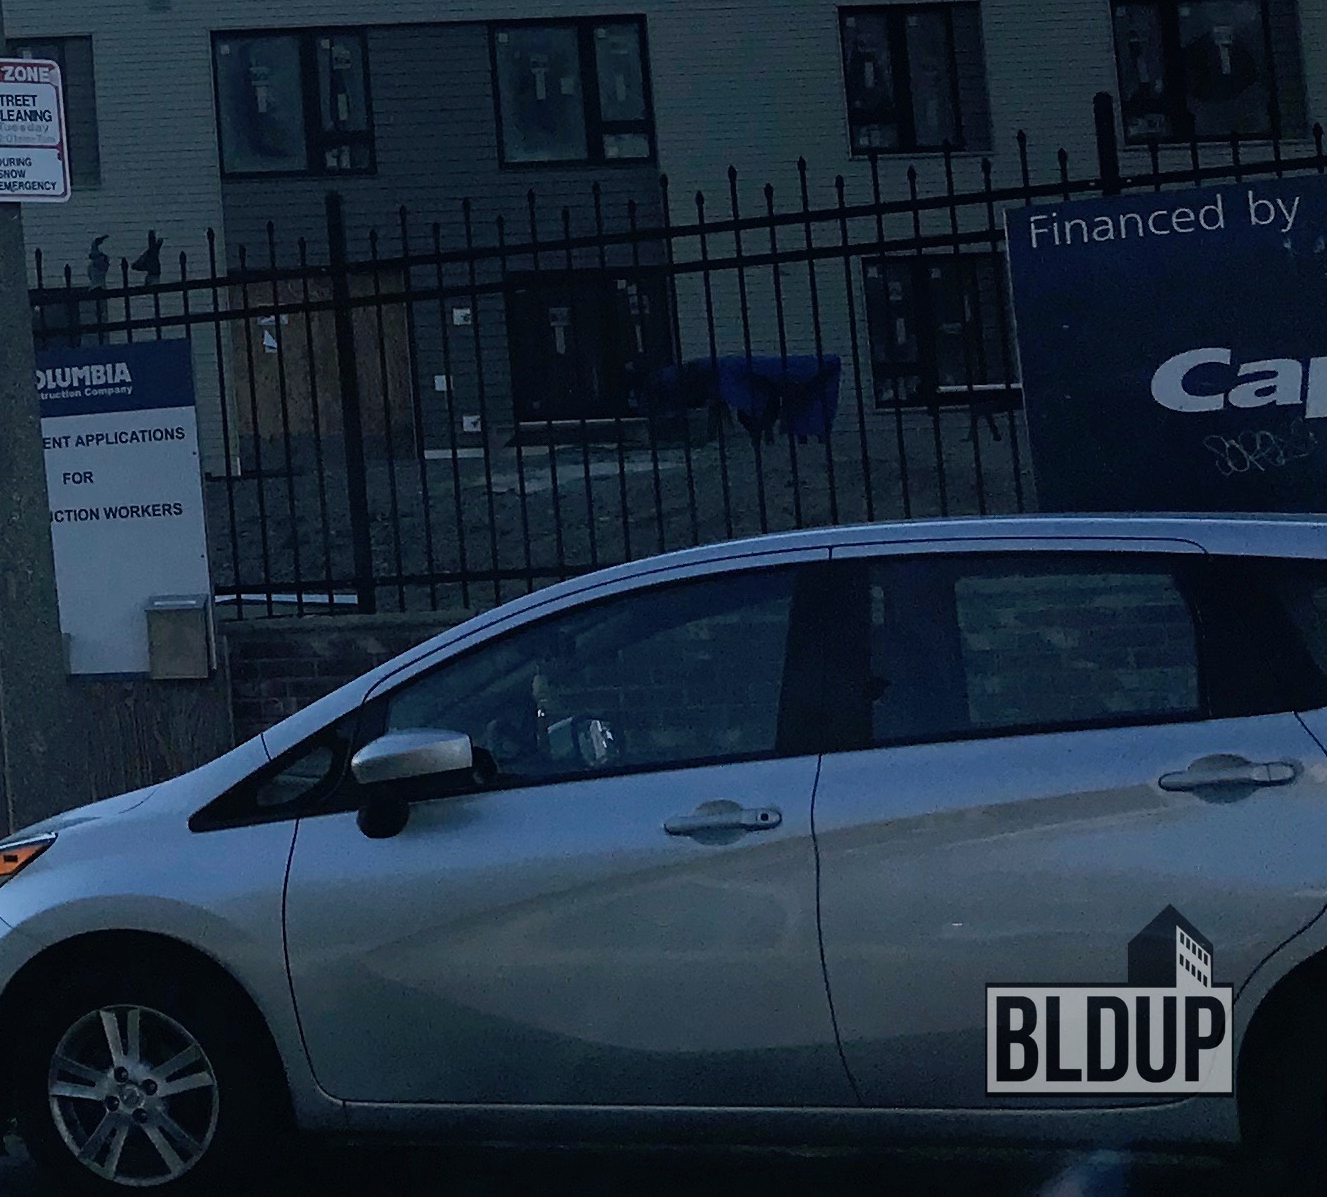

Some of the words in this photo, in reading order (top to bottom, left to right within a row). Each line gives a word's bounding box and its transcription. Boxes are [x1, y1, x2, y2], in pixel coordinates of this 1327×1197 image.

[1, 65, 50, 83] ZONE
[1029, 193, 1225, 248] Financed
[1248, 190, 1300, 233] by
[35, 362, 133, 390] OLUMBIA
[40, 389, 82, 400] truction
[84, 386, 134, 397] Company
[75, 426, 186, 448] APPLICATIONS
[62, 471, 95, 485] FOR
[104, 502, 184, 520] WORKERS
